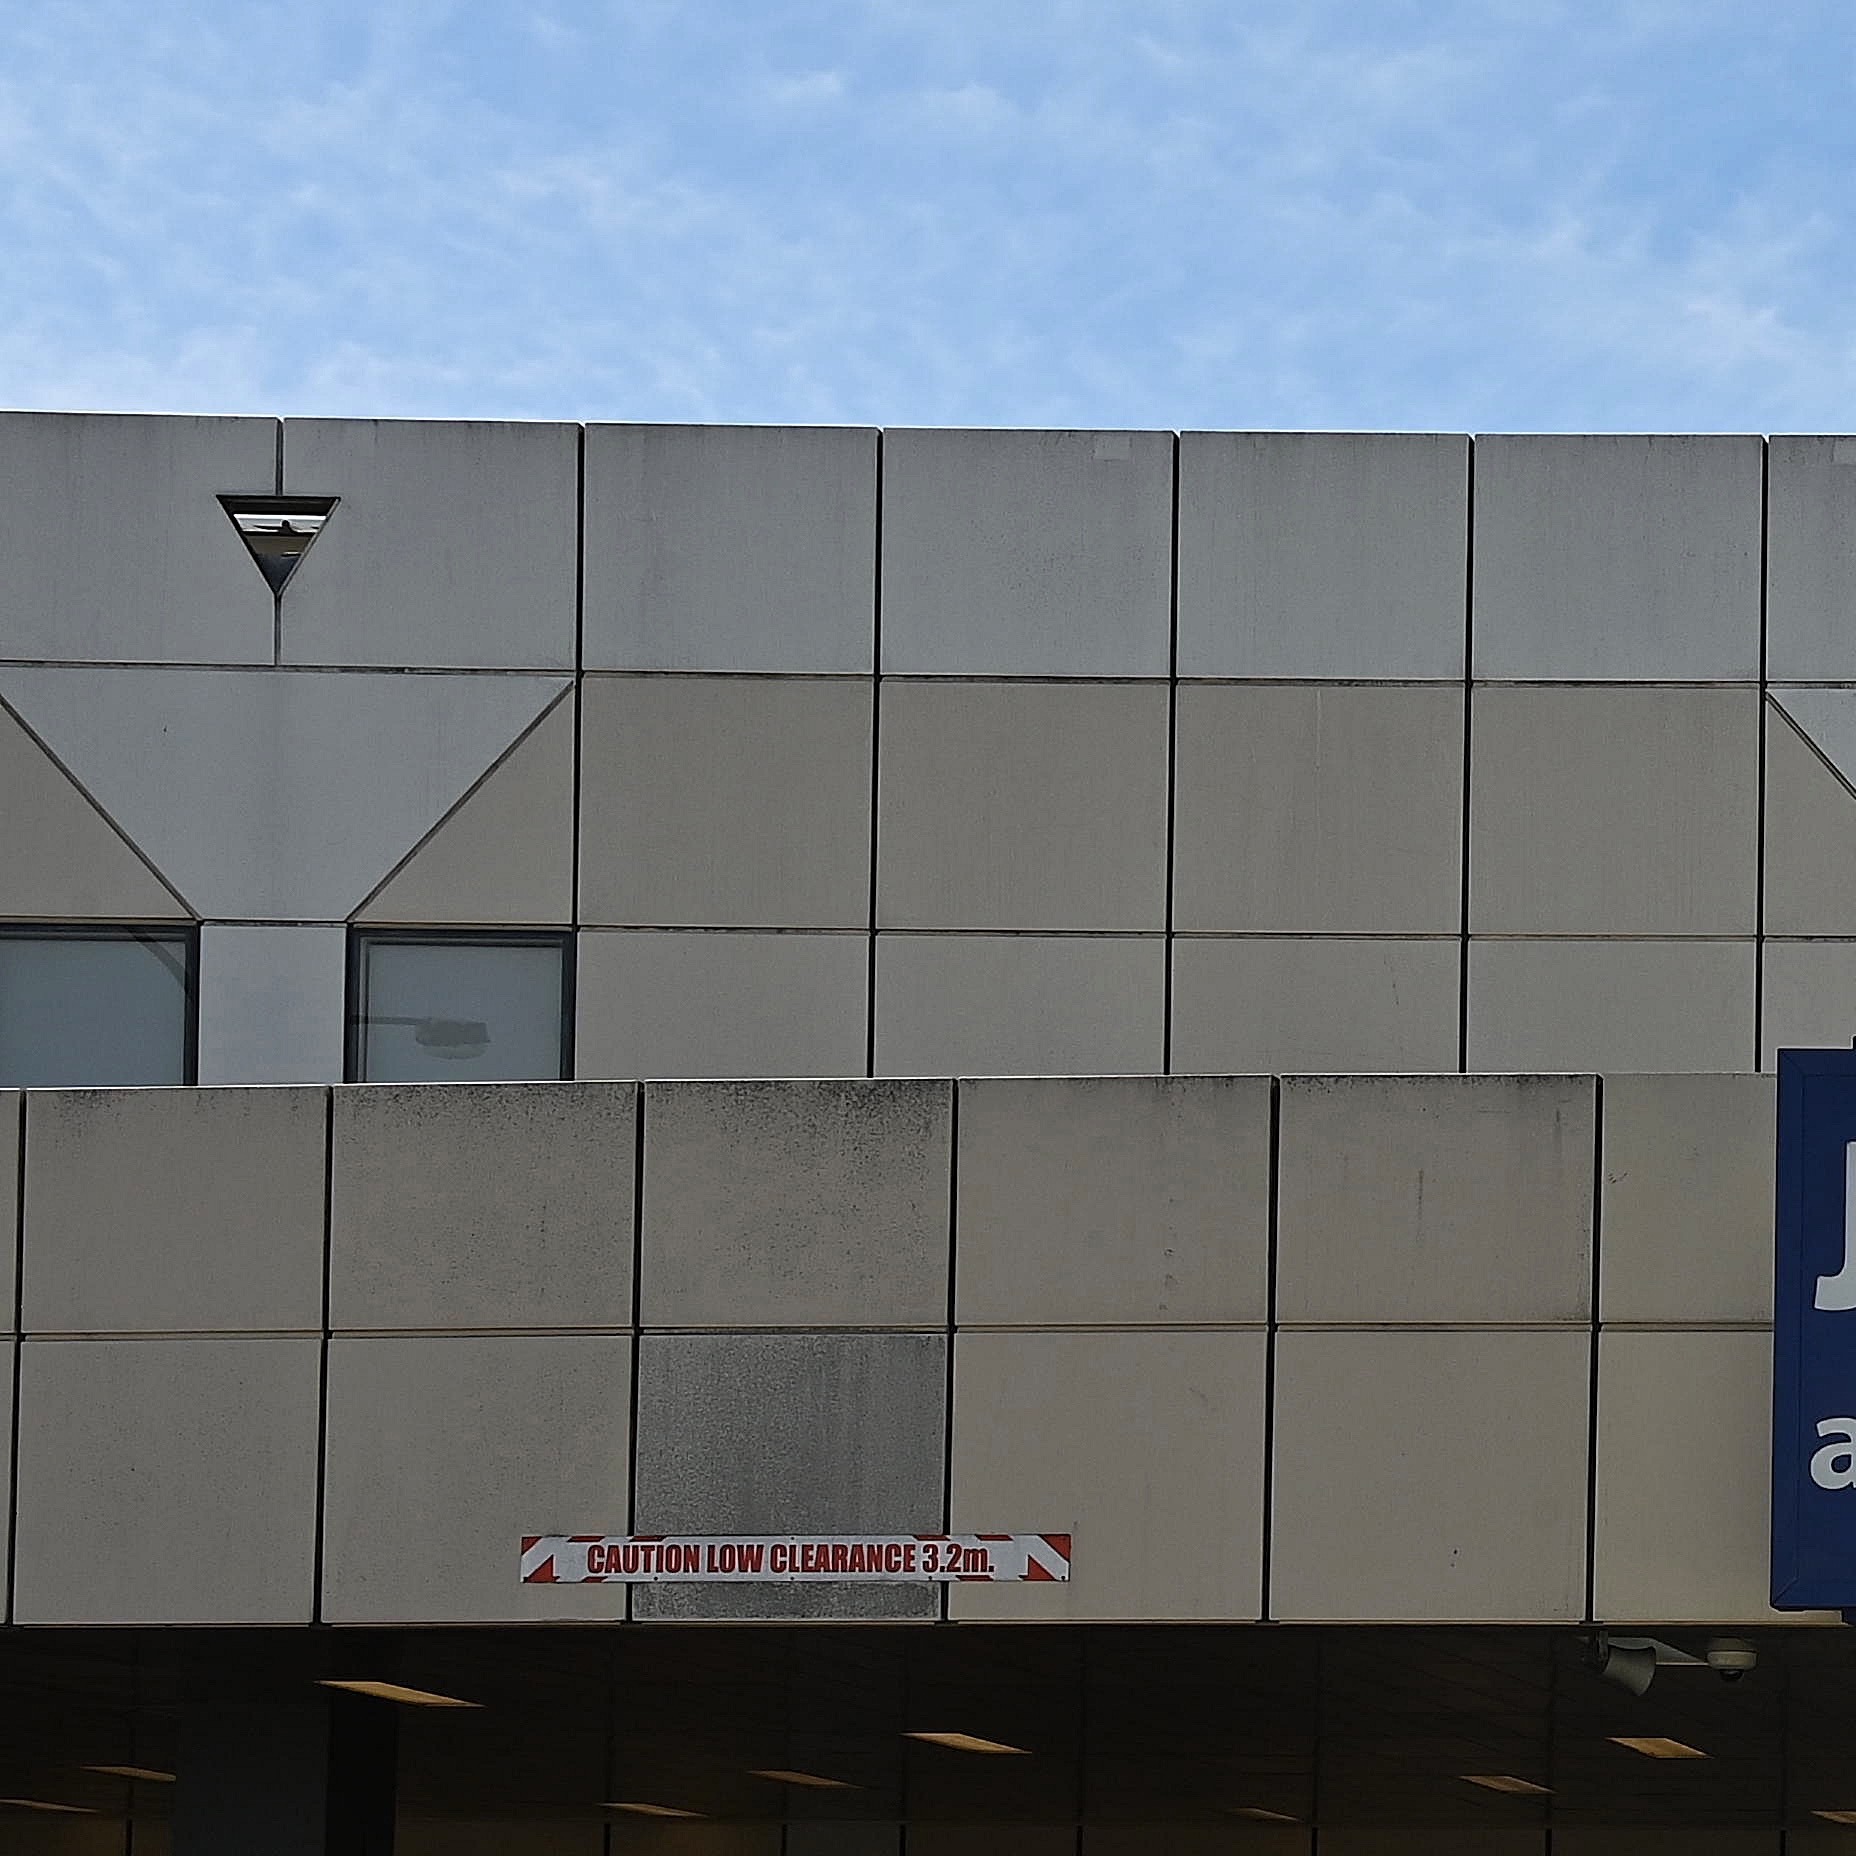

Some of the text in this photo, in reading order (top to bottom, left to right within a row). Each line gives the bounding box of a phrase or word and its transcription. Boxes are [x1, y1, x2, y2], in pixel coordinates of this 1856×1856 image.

[587, 1544, 994, 1574] CAUTION LOW CLEARANCE 3.2m.
